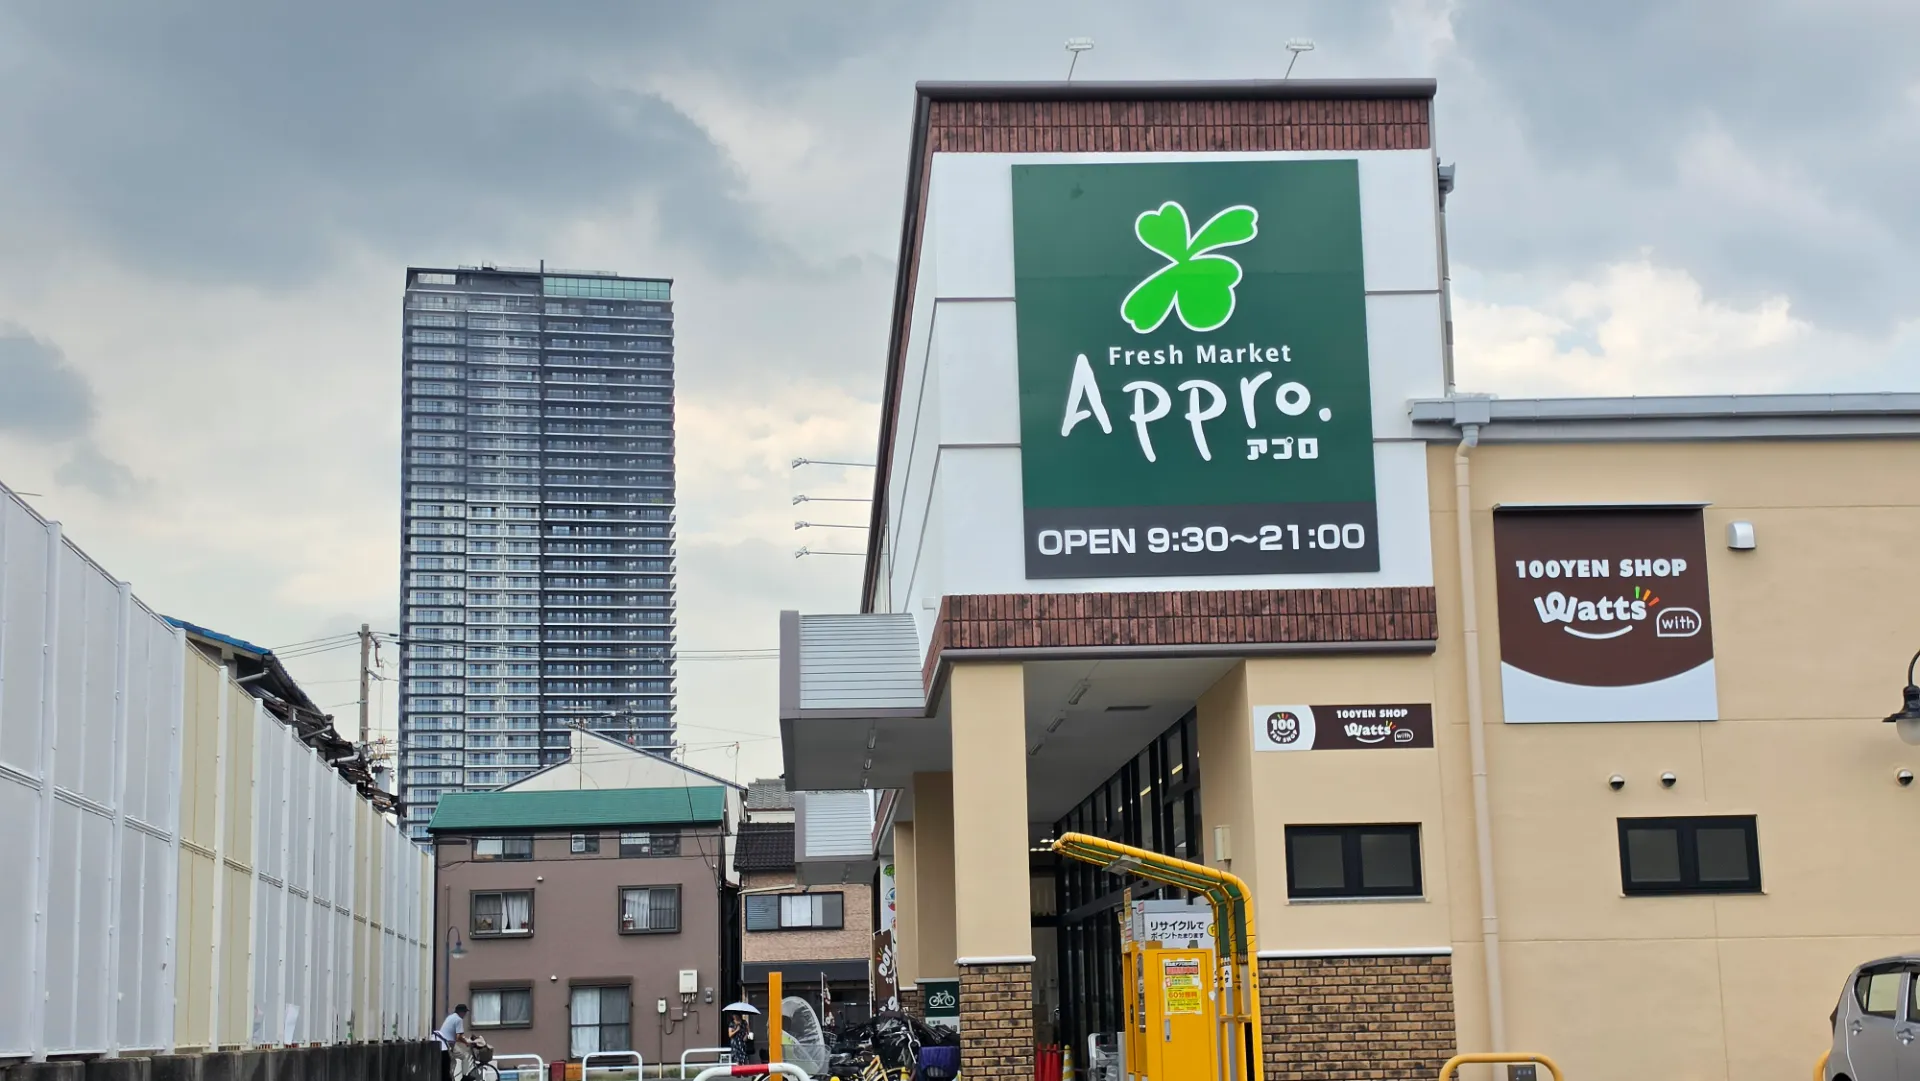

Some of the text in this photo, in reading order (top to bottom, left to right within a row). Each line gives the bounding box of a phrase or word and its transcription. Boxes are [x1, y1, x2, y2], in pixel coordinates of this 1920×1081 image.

[1109, 343, 1292, 366] Fresh Market
[1061, 353, 1332, 463] Appro.
[1246, 436, 1319, 461] アプロ
[1038, 528, 1137, 556] OPEN
[1516, 558, 1688, 579] 100YEN SHOP
[1533, 590, 1648, 624] Watts
[1661, 616, 1696, 631] with
[1336, 708, 1408, 719] 100YEN SHOP
[1271, 718, 1296, 731] 100
[1343, 722, 1391, 737] Watts
[1150, 920, 1204, 931] リサイクルで
